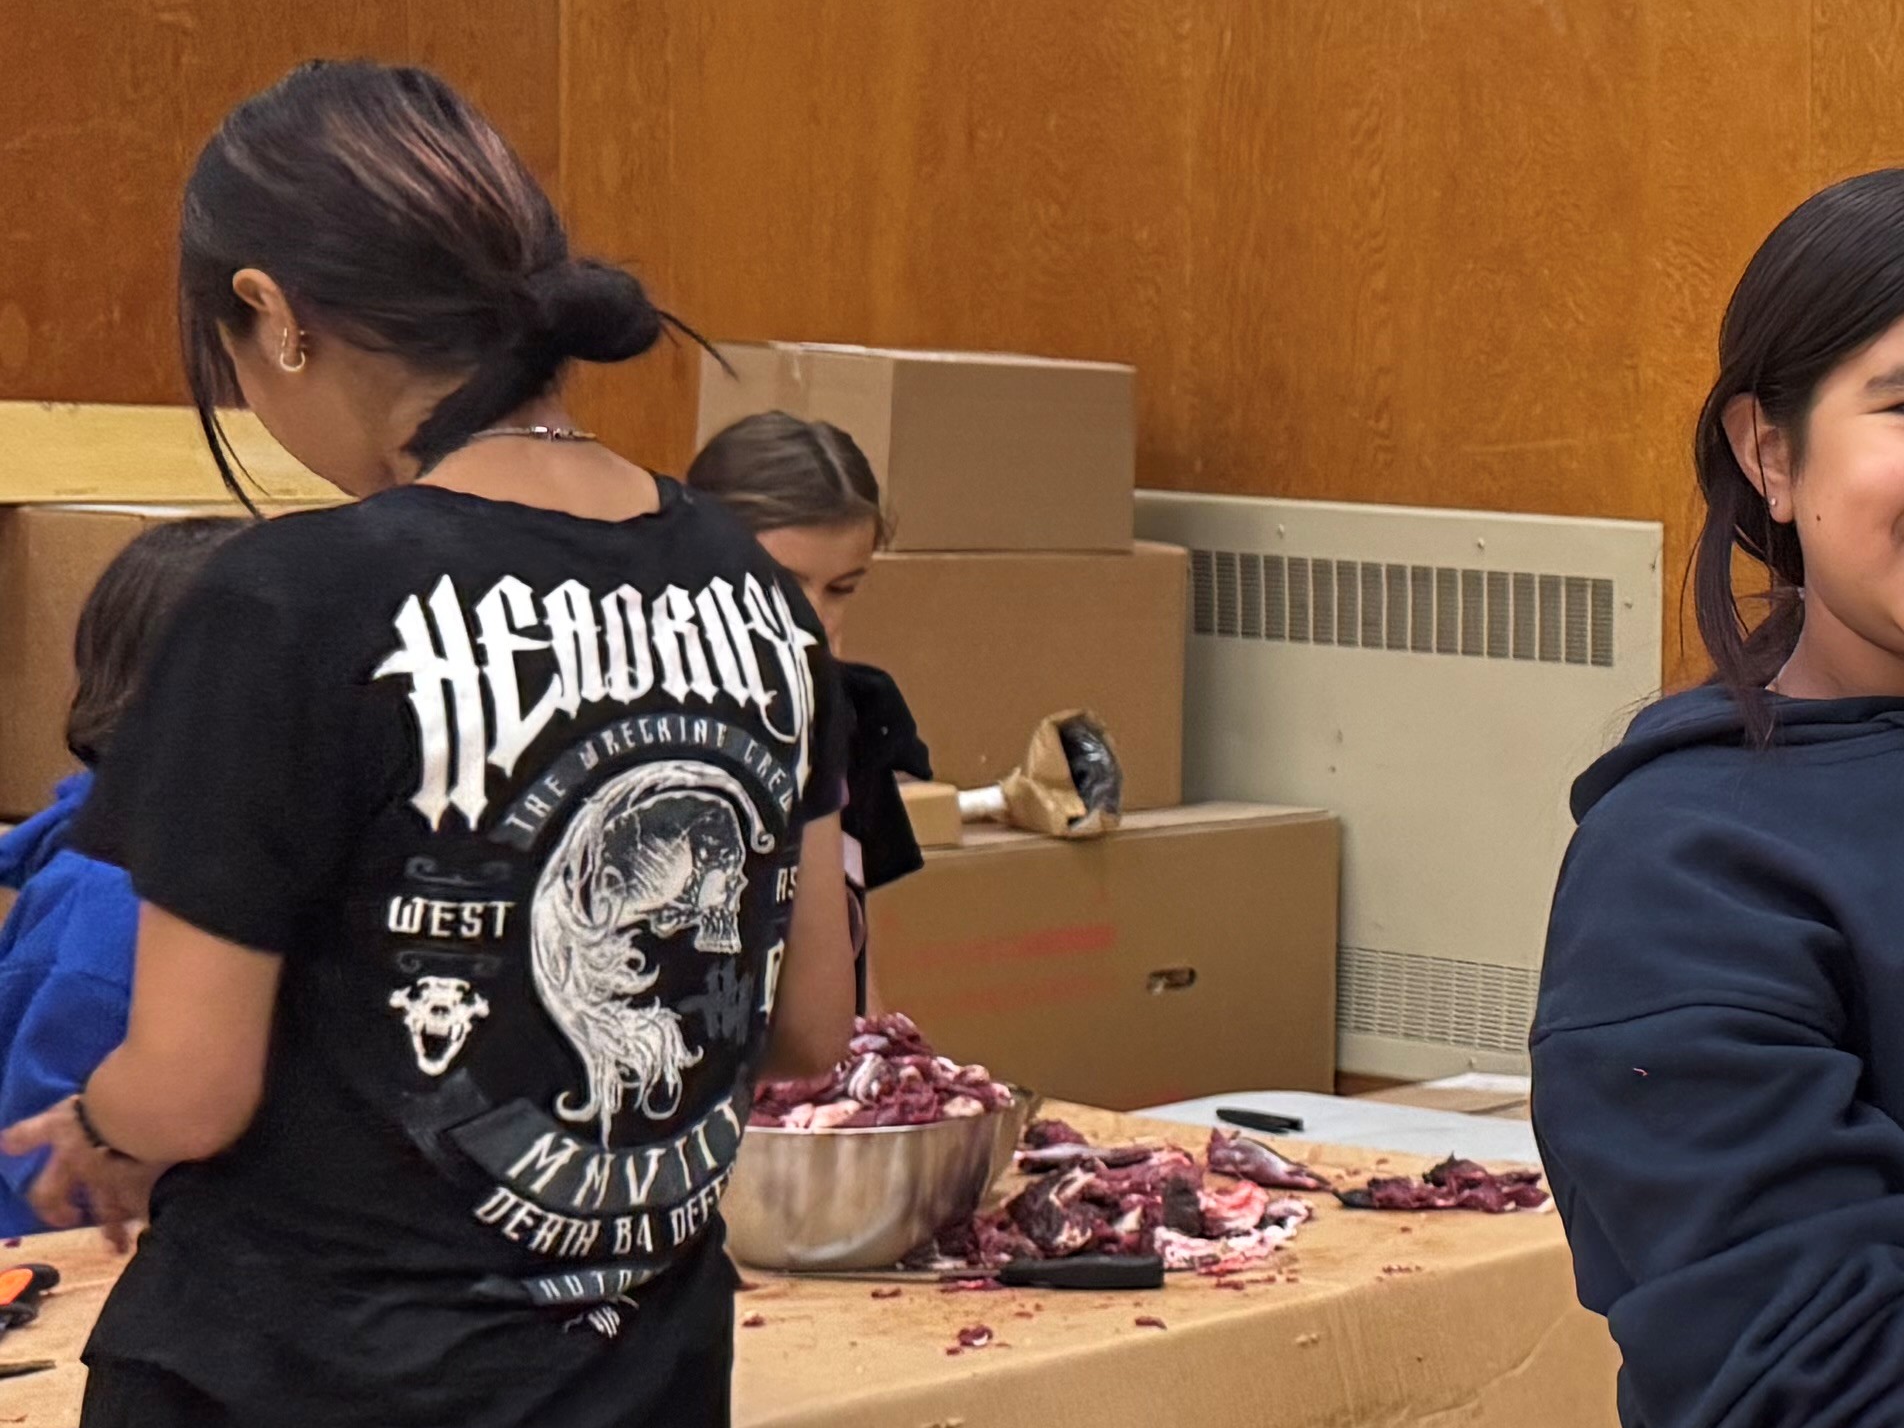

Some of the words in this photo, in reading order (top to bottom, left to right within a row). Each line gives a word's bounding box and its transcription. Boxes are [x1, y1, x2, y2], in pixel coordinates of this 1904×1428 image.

[505, 775, 567, 833] THE
[387, 895, 516, 939] WEST
[473, 1186, 601, 1257] DEATH
